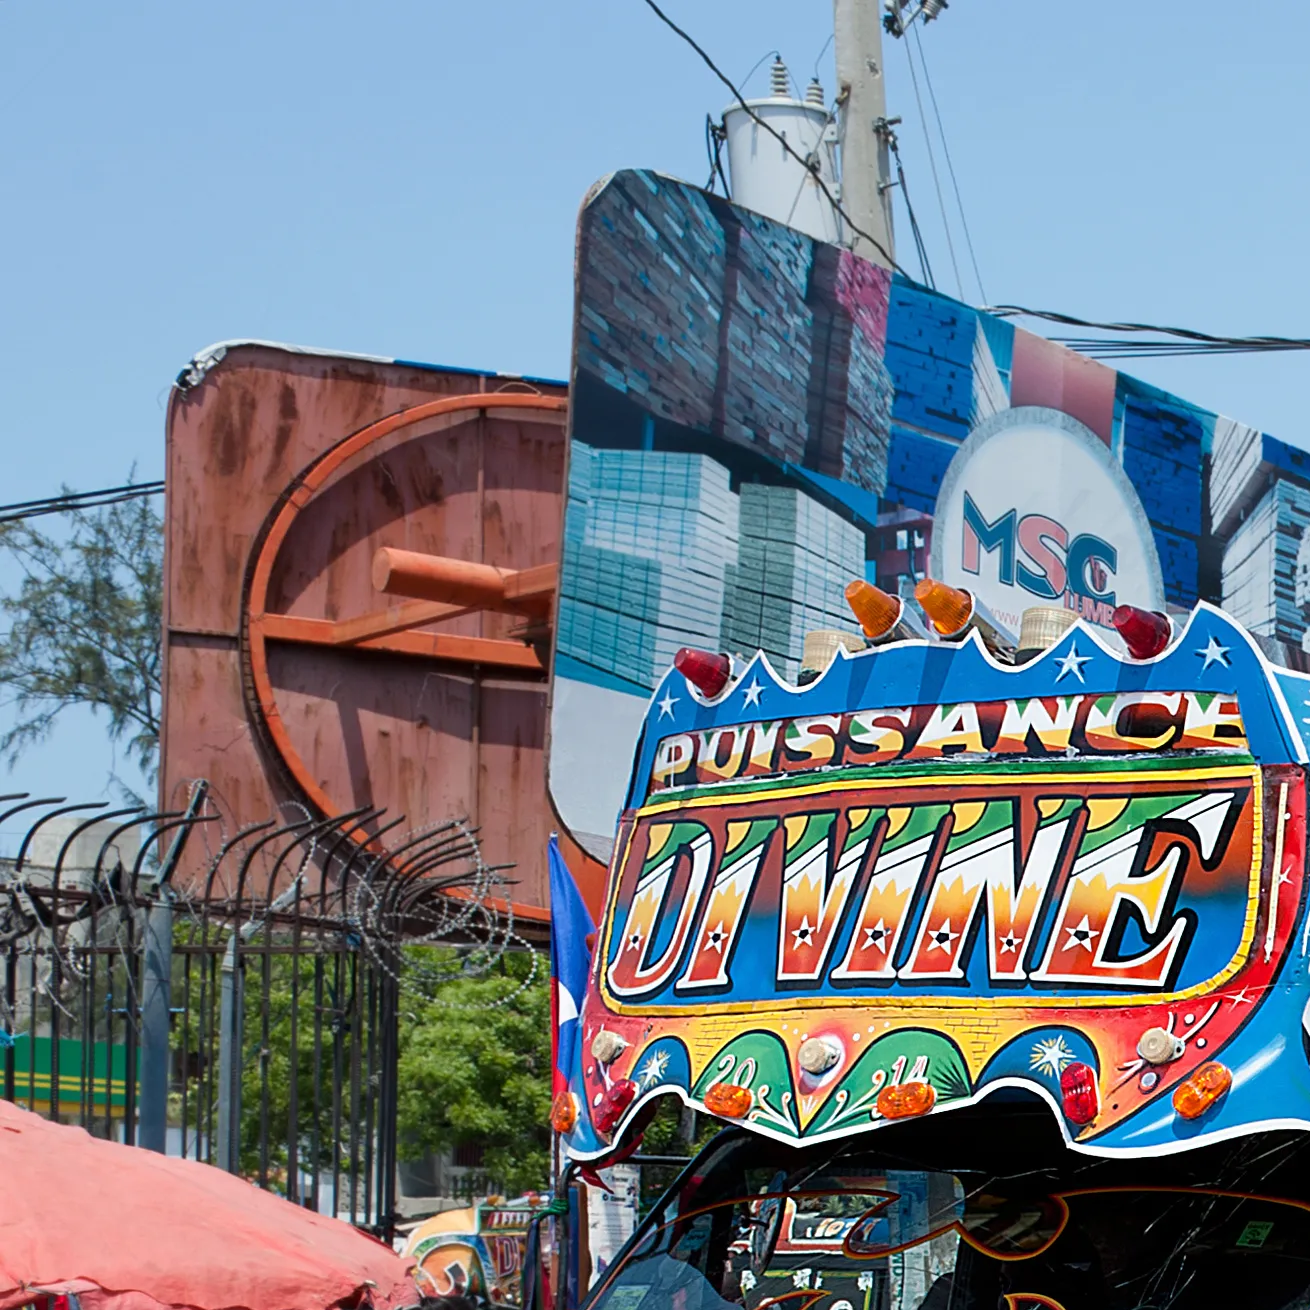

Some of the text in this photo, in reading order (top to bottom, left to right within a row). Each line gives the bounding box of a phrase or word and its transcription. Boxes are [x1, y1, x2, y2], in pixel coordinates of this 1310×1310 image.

[962, 490, 1117, 607] MSC
[1064, 590, 1115, 629] LUMB
[650, 692, 1247, 790] PUISSANCE
[606, 790, 1246, 997] DIVINE
[705, 1054, 928, 1086] 20 14
